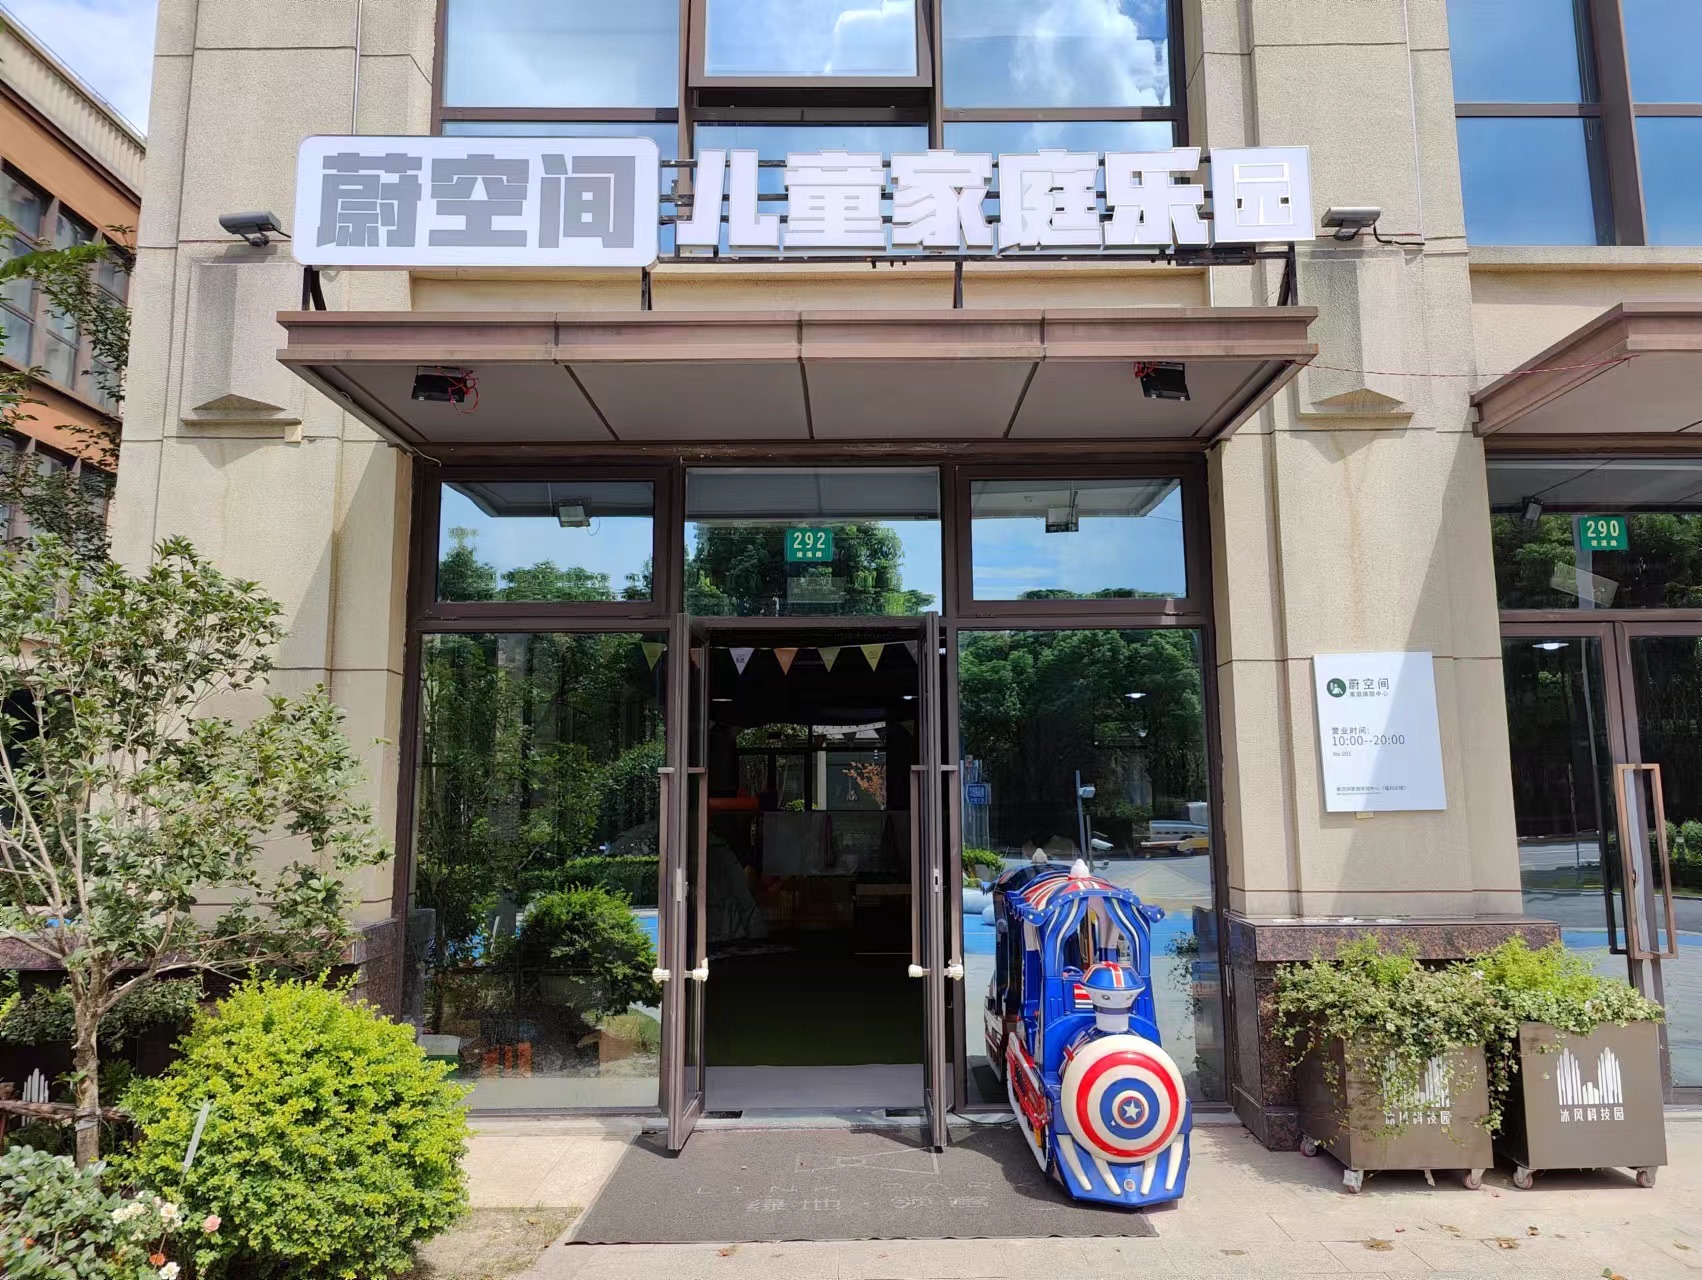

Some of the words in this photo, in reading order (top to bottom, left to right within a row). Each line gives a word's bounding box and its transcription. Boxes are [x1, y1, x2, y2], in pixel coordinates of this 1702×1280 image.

[316, 152, 636, 249] 蔚空间
[676, 145, 1316, 251] 儿童家庭乐园
[1586, 520, 1619, 538] 290
[793, 532, 826, 549] 292
[1348, 678, 1390, 690] 蔚空间
